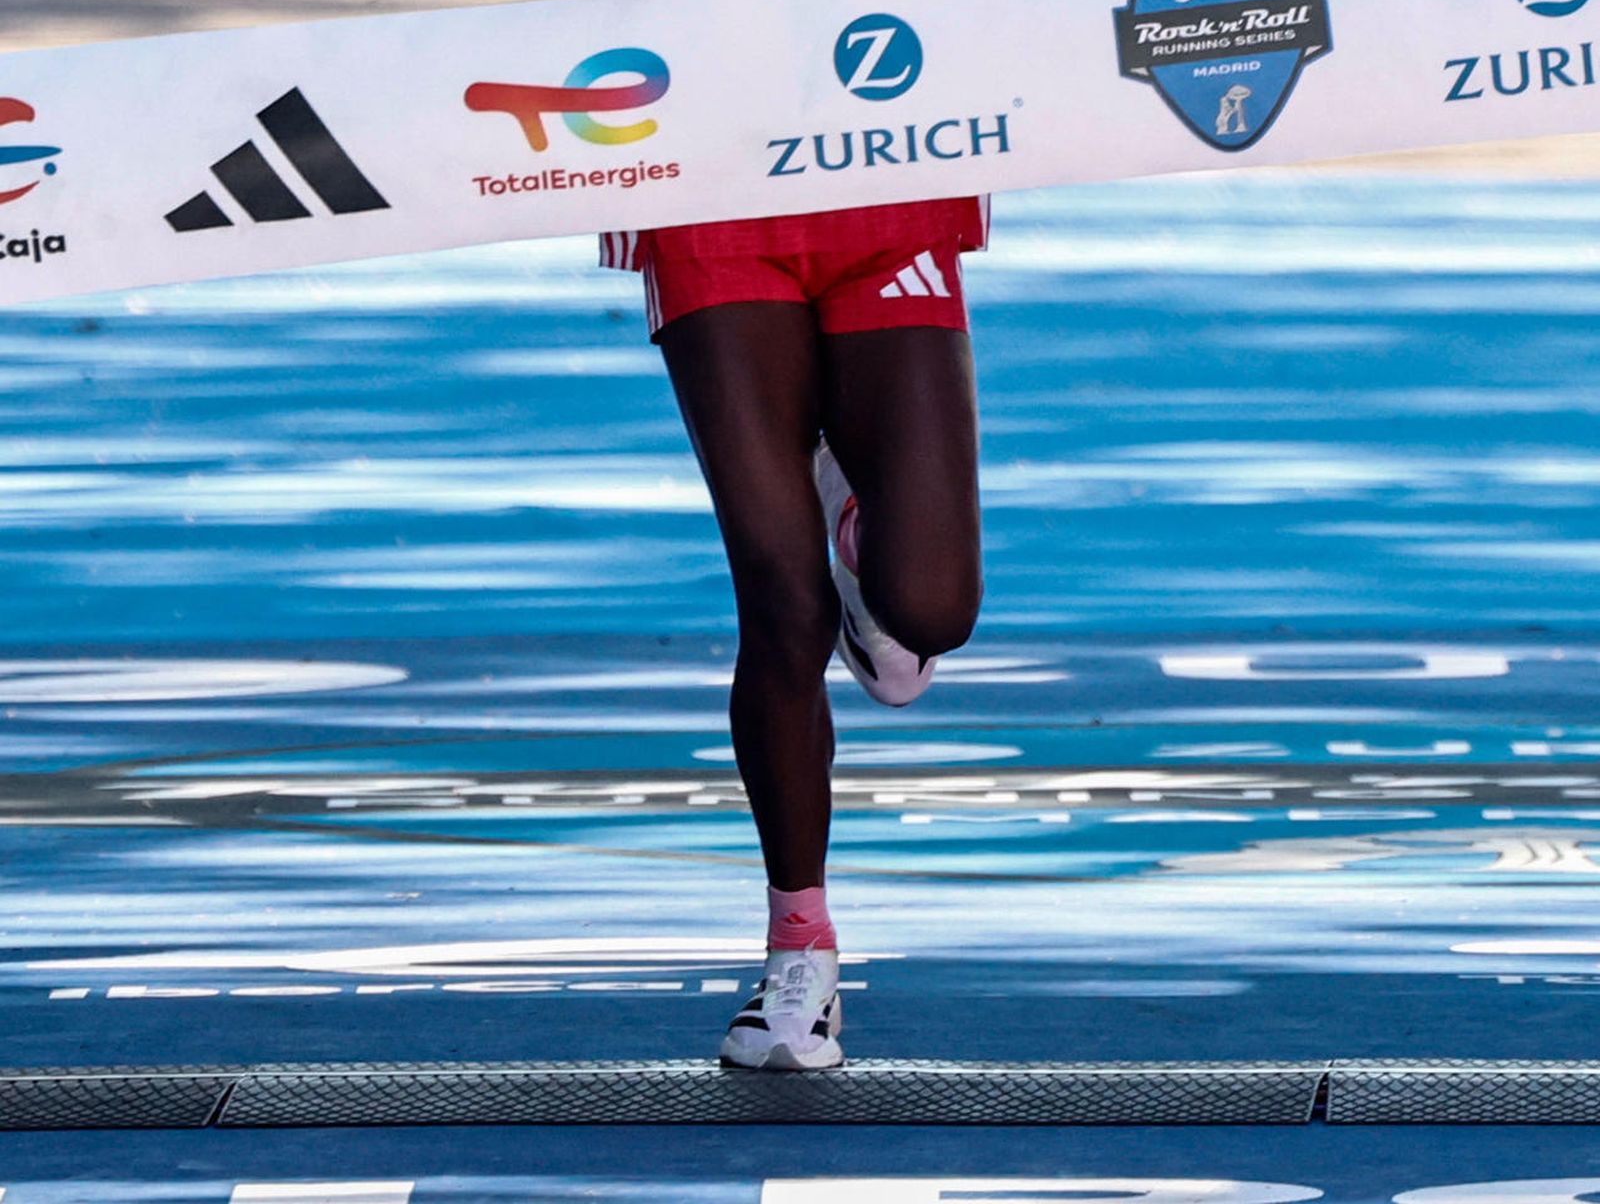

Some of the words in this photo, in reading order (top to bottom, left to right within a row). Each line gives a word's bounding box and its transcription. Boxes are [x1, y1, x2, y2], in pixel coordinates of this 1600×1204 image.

[1152, 39, 1231, 57] RUNNING
[1235, 29, 1296, 47] SERIES
[1193, 61, 1261, 78] MADRID
[767, 114, 1011, 177] ZURICH
[472, 160, 680, 196] TotalEnergies
